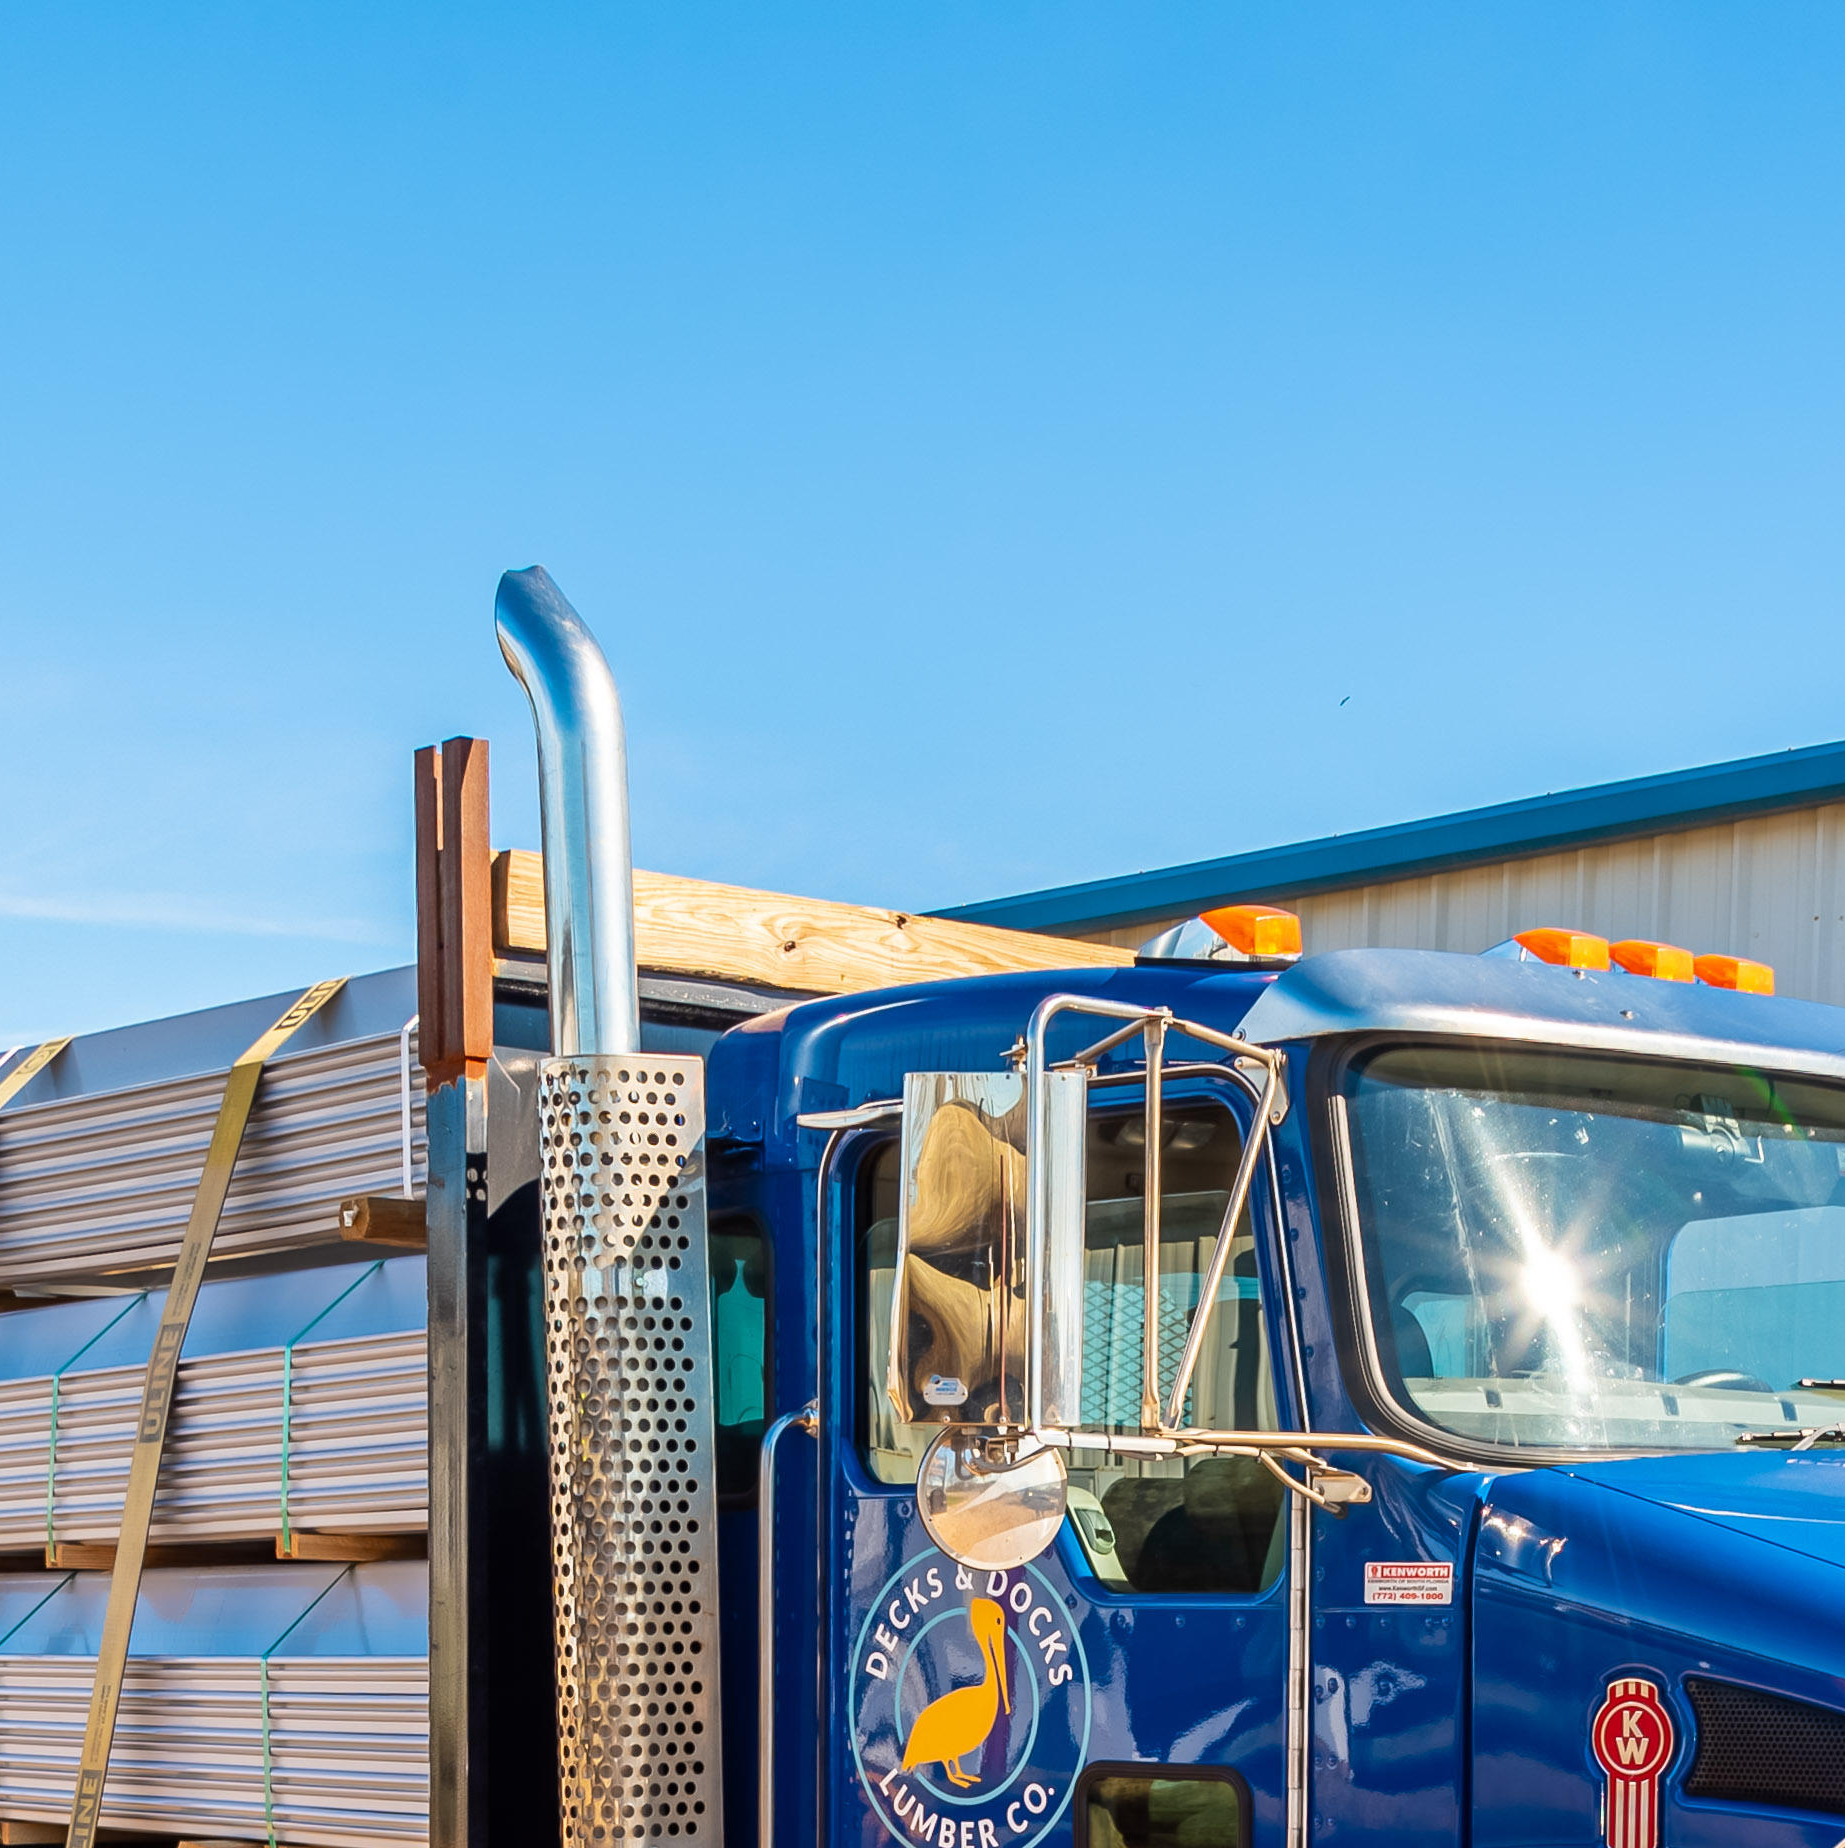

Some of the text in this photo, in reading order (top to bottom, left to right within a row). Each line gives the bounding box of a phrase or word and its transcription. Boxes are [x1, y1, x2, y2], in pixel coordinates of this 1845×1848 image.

[142, 1326, 181, 1438] ULINE
[1373, 1592, 1396, 1600] (772)
[1382, 1567, 1448, 1577] KENWORTH
[865, 1564, 1073, 1686] DECKS & DOCKS
[1006, 1782, 1055, 1833] CO.
